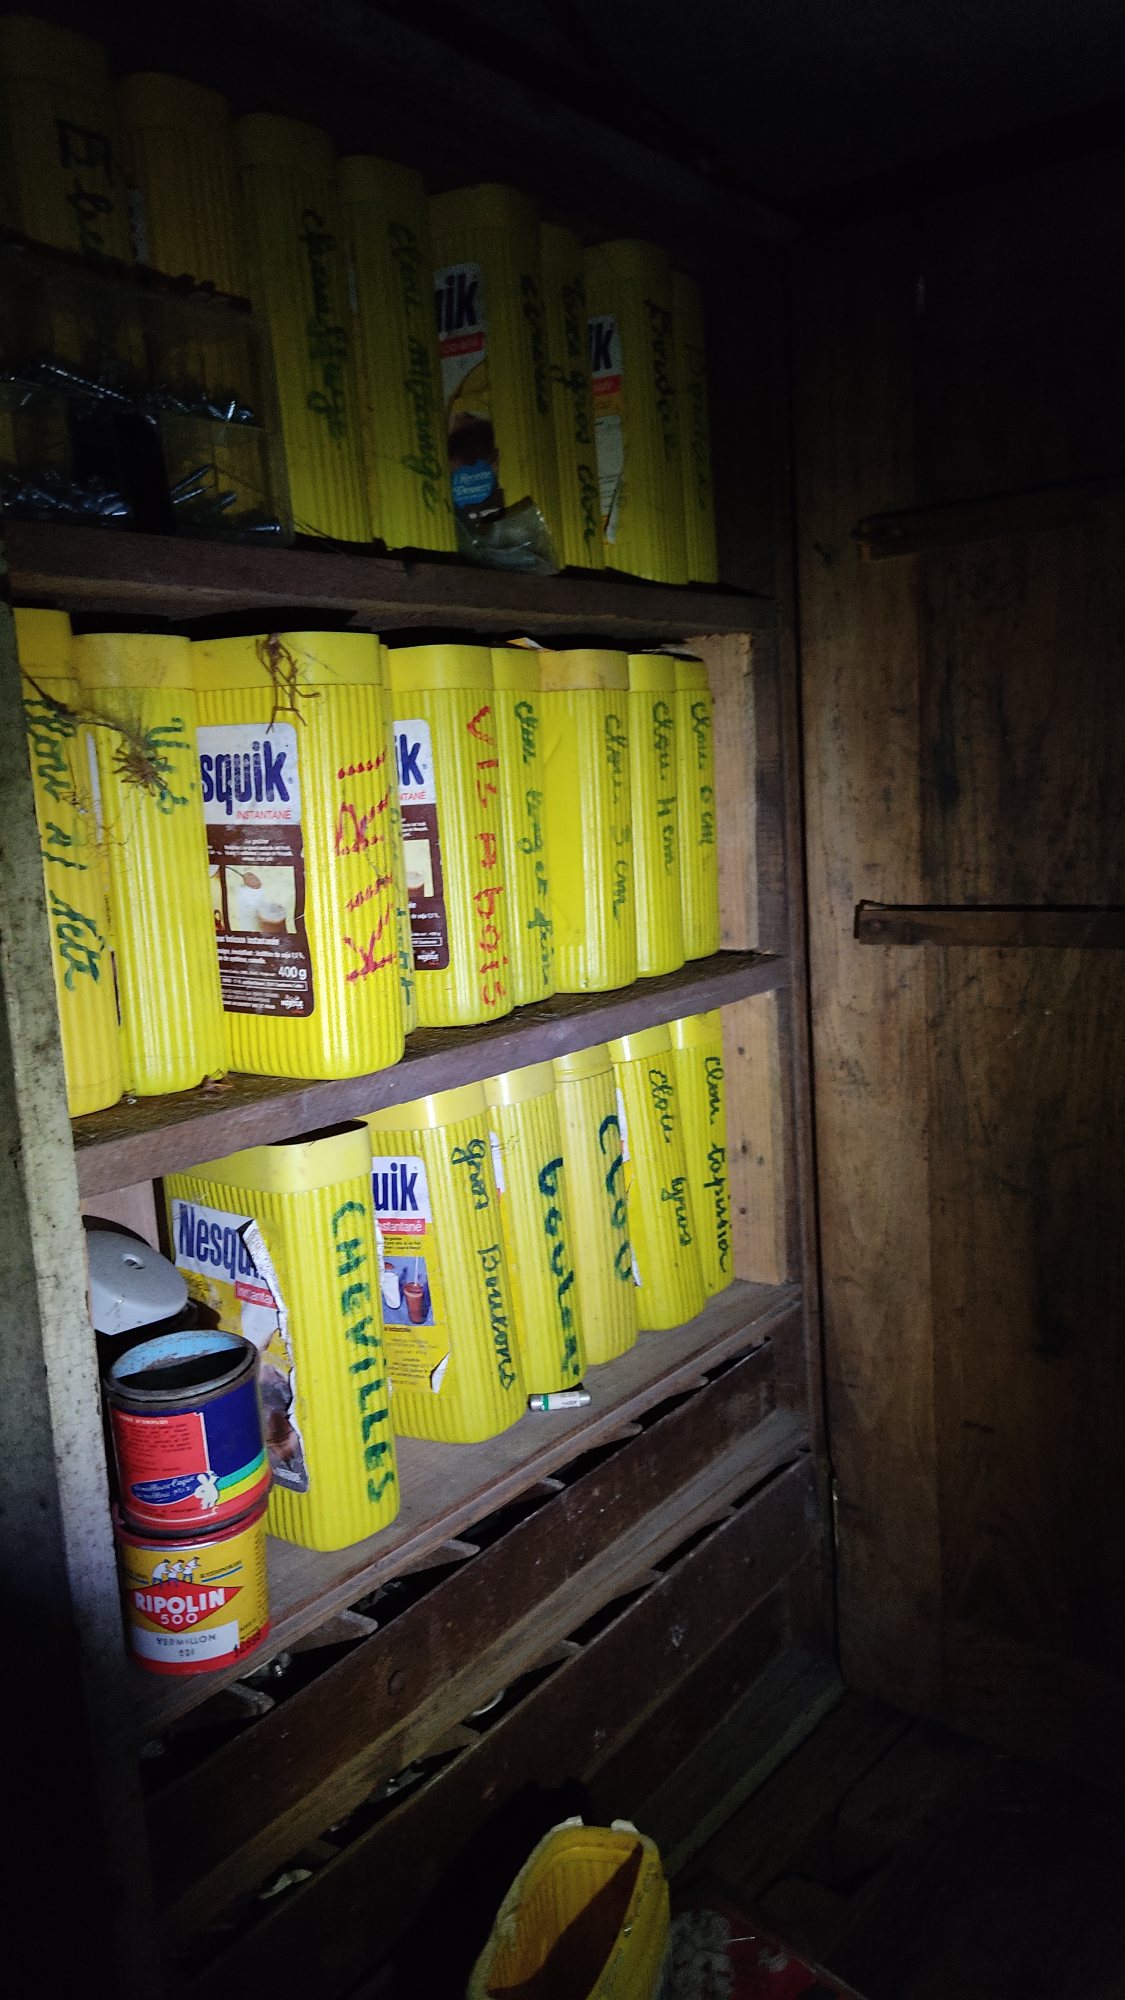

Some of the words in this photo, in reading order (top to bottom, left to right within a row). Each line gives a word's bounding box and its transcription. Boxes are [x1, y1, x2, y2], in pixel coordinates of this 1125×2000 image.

[236, 809, 292, 820] INSTANTANÉ
[134, 1587, 226, 1615] RIPOLIN
[160, 1612, 199, 1625] 500
[156, 1633, 217, 1646] VERMILLON
